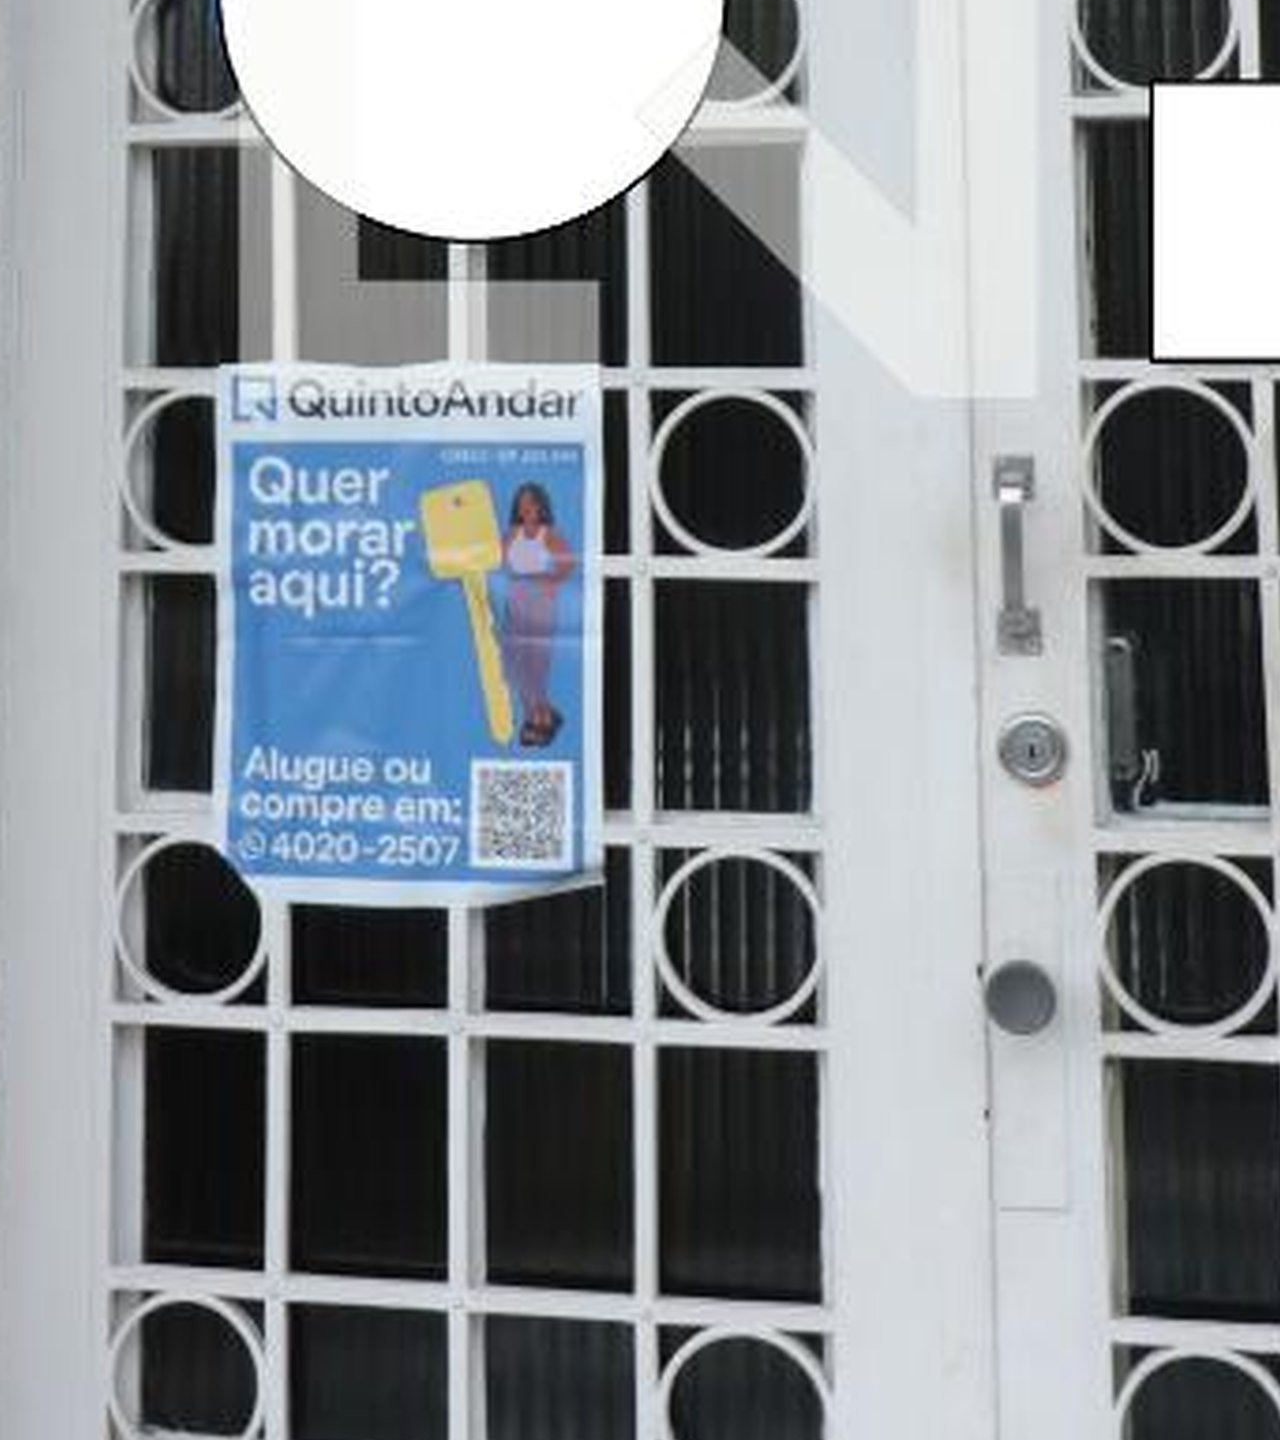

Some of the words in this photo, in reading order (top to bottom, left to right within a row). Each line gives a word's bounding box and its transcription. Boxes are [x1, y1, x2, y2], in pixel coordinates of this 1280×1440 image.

[288, 377, 583, 421] QuintoAndar
[248, 455, 391, 507] Quer
[248, 518, 416, 559] morar
[248, 558, 402, 618] aqui?
[244, 745, 375, 791] Alugue
[383, 754, 432, 785] ou
[239, 789, 386, 827] compre
[394, 795, 462, 825] em:
[271, 829, 461, 866] 4020-2507
